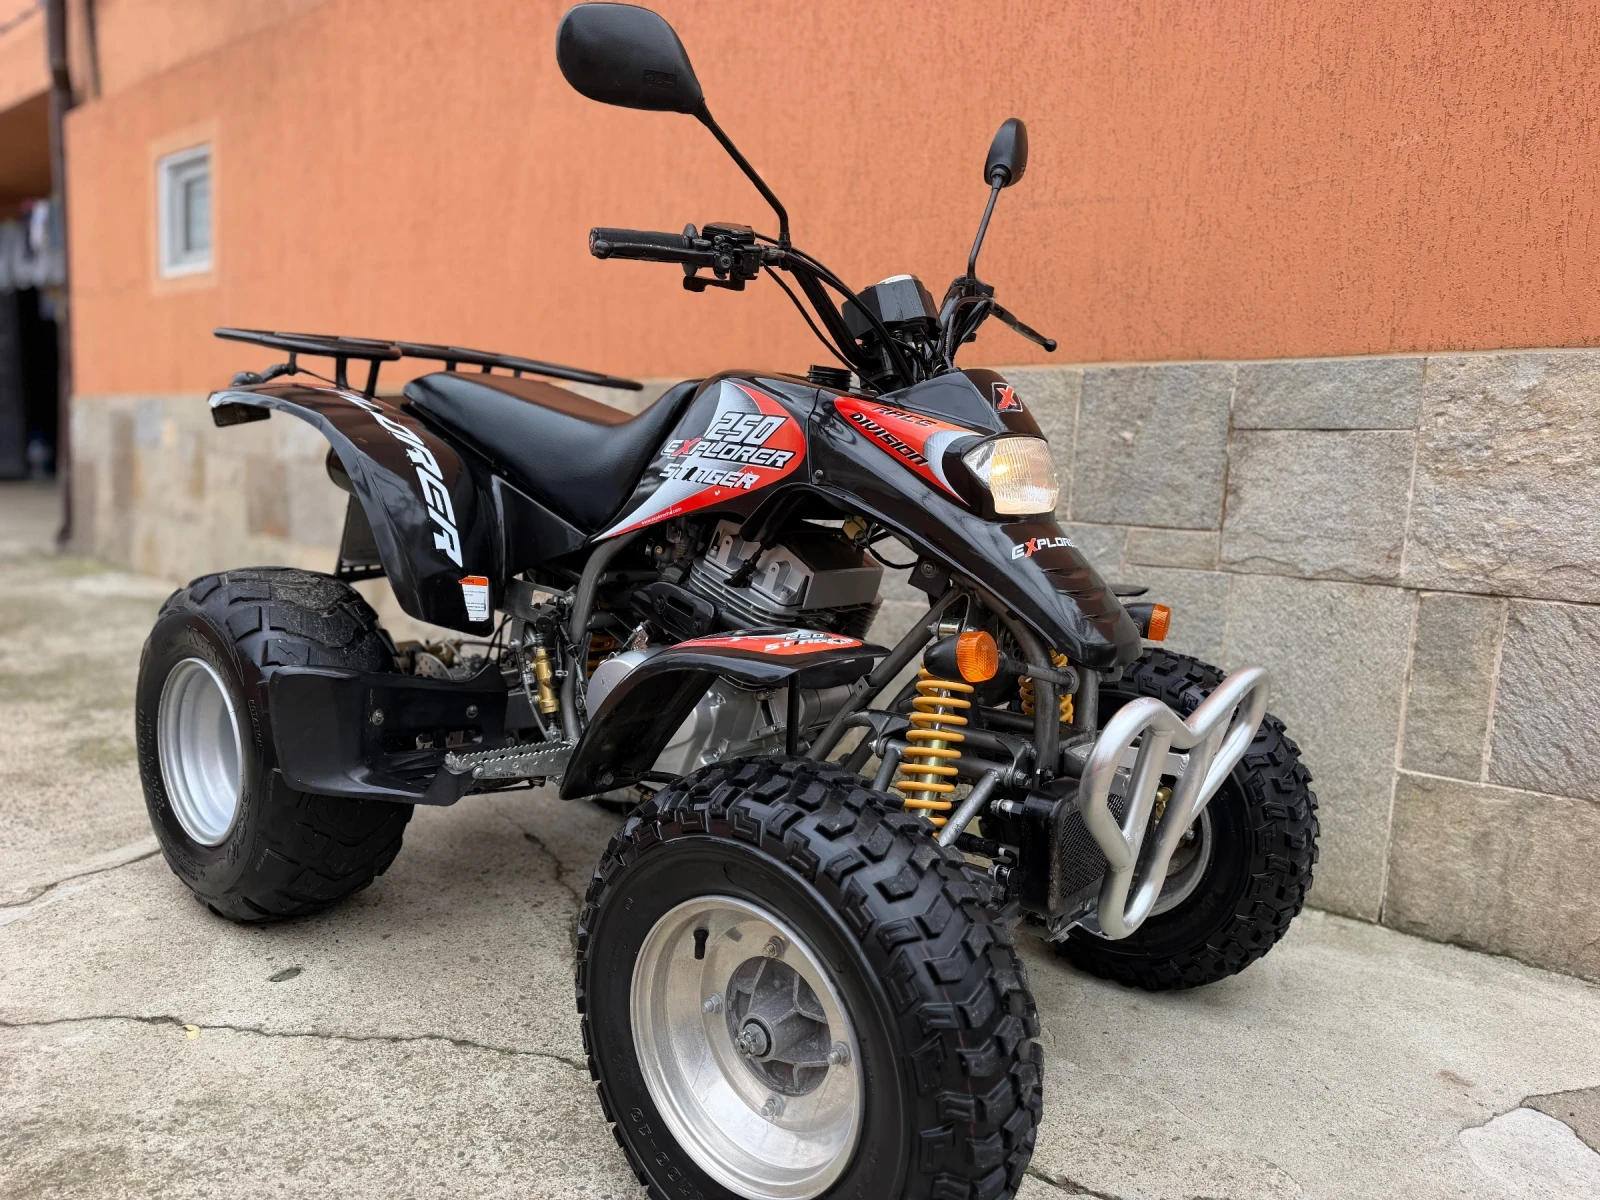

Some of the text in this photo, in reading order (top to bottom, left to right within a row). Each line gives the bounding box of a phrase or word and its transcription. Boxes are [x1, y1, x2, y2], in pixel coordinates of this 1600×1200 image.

[705, 412, 789, 447] 250
[873, 407, 937, 428] RACE
[661, 437, 797, 469] EXPLORER
[849, 412, 929, 467] DIVISION
